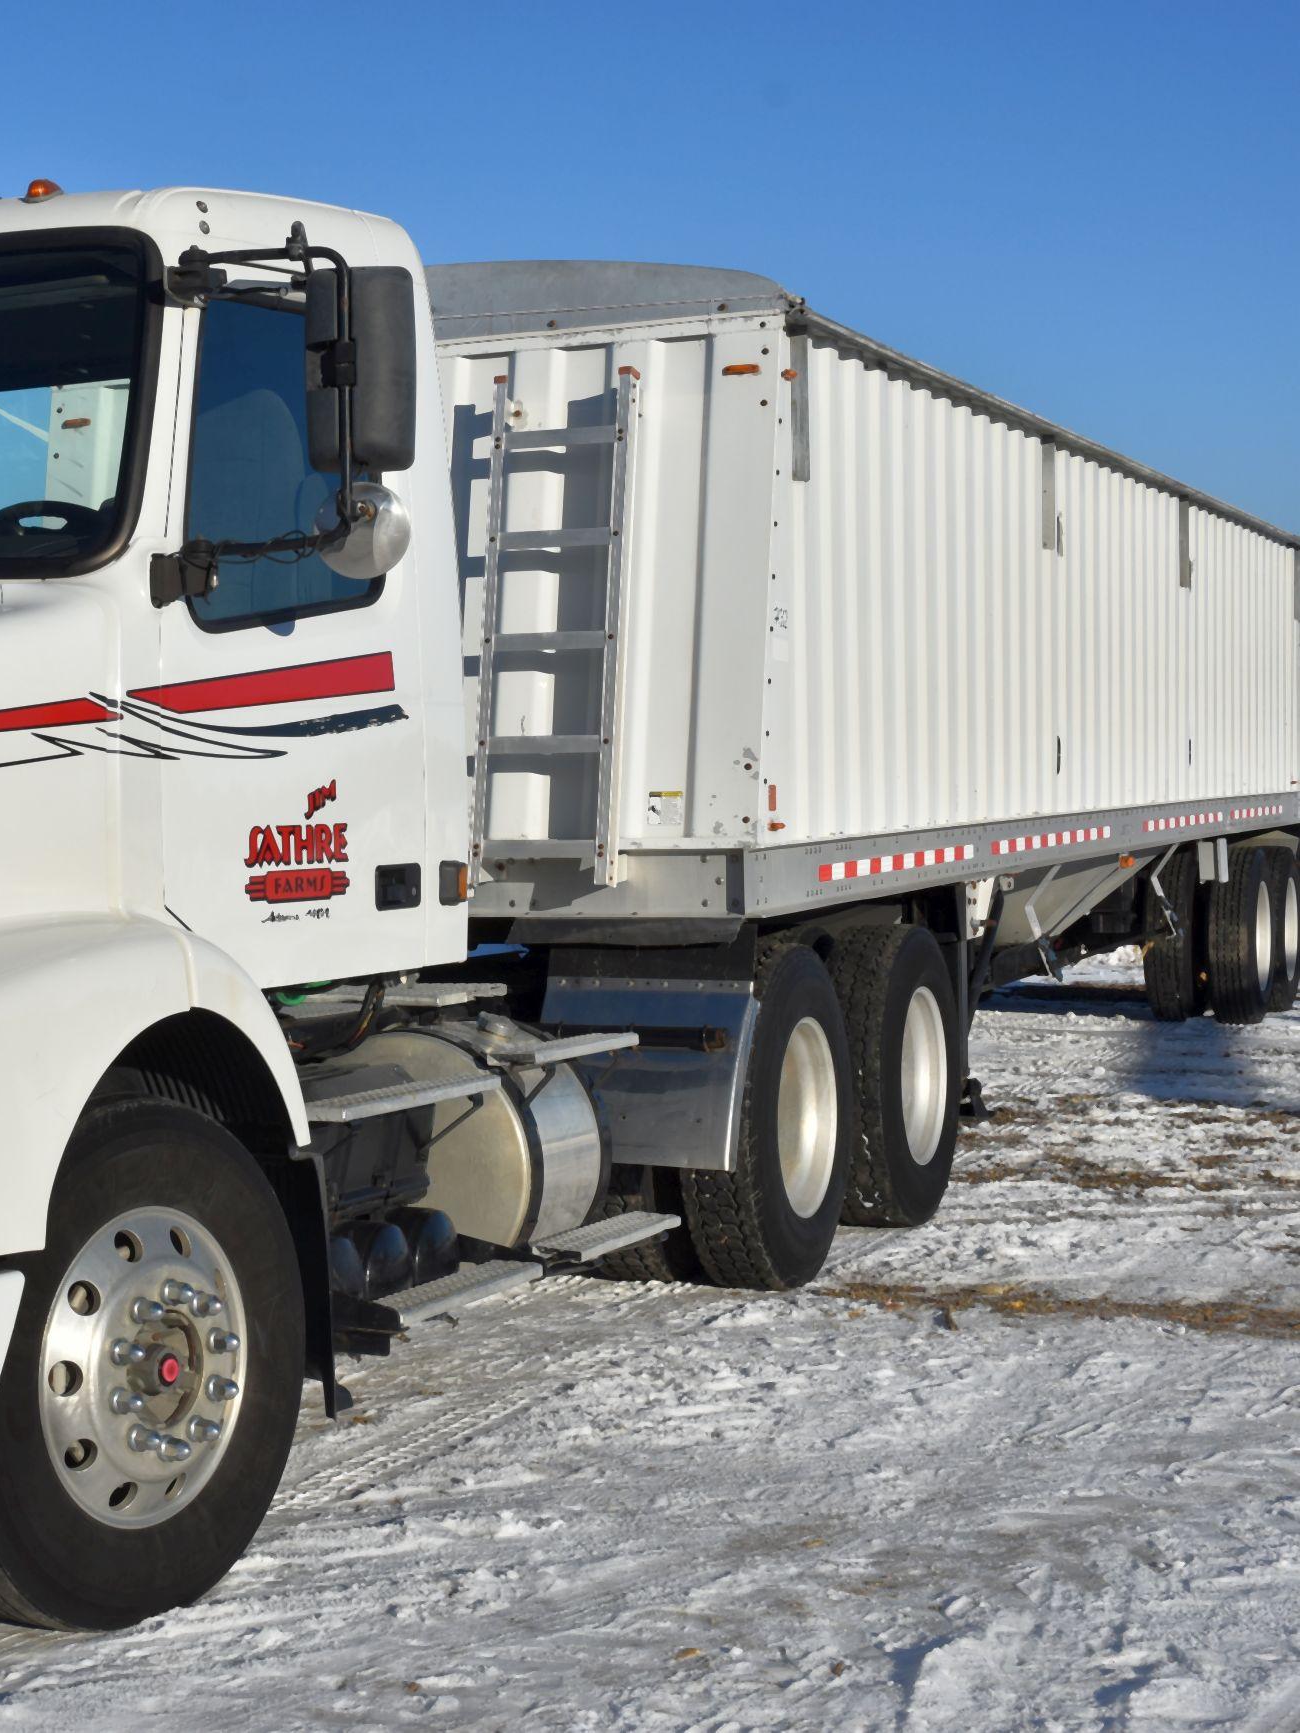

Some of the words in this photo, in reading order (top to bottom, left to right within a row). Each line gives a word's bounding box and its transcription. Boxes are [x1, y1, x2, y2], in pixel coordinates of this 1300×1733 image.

[304, 779, 336, 820] JIM
[244, 823, 349, 868] SATHRE
[274, 875, 326, 895] FARMS
